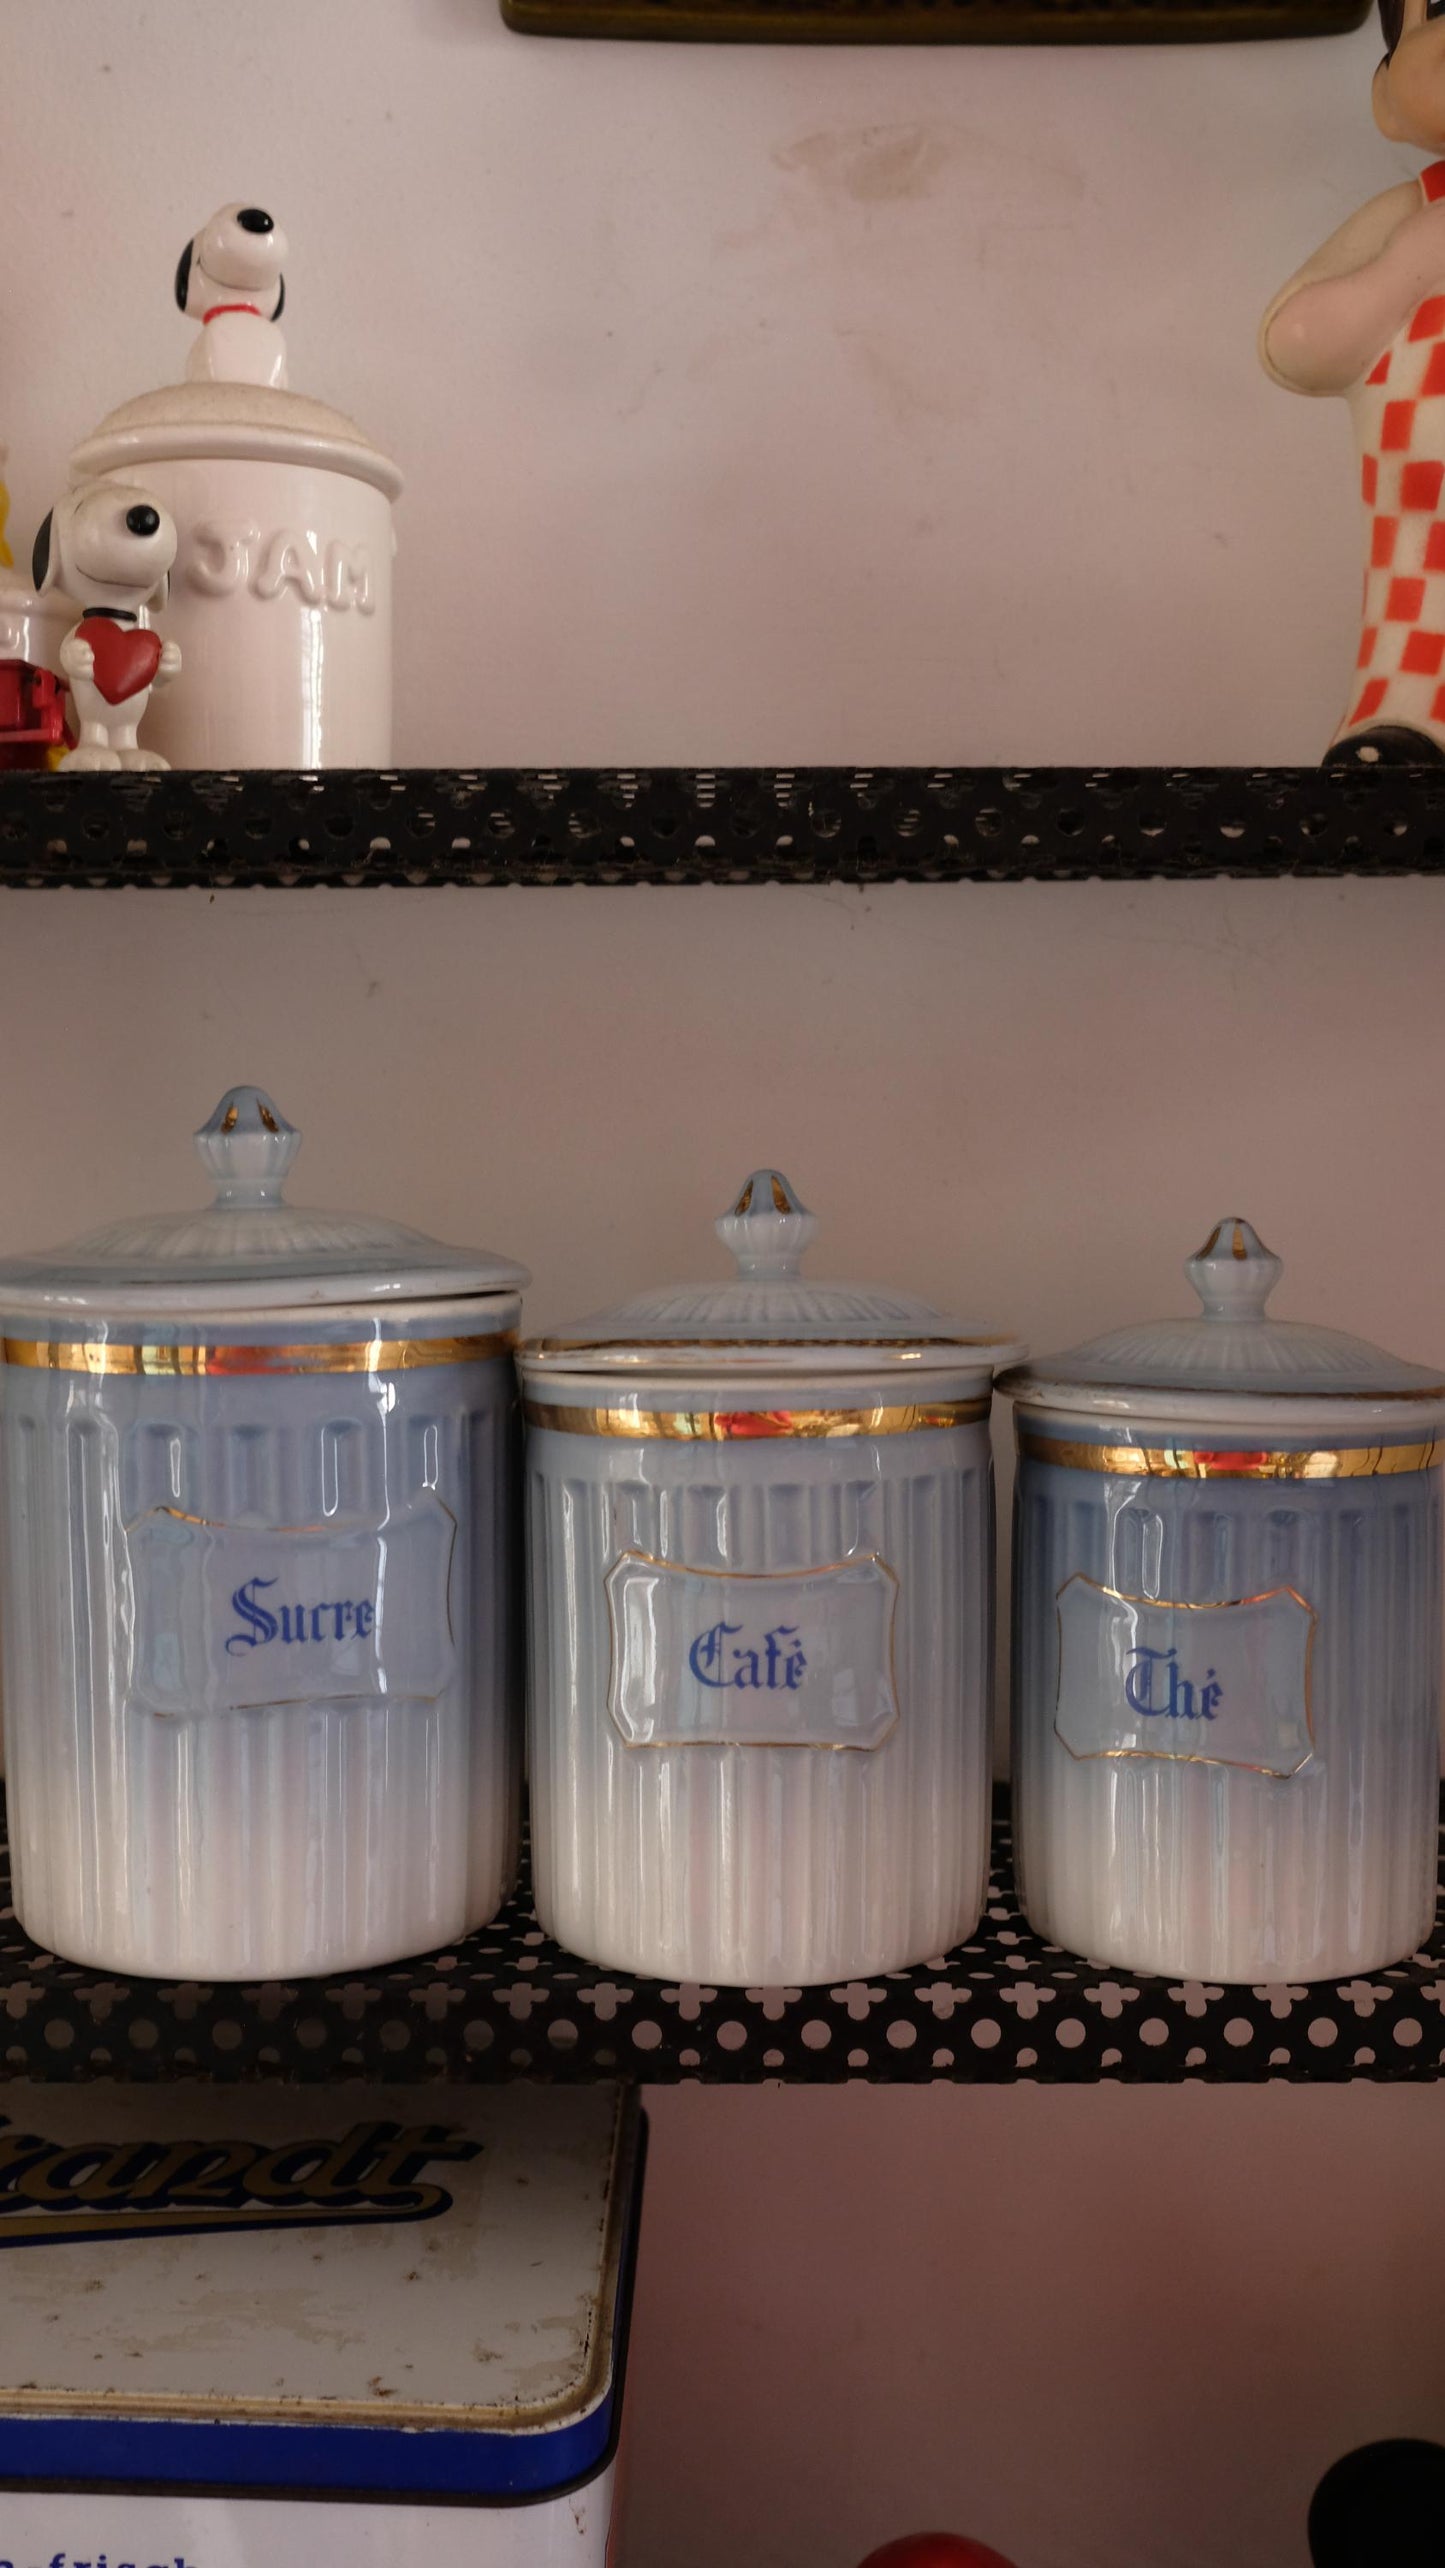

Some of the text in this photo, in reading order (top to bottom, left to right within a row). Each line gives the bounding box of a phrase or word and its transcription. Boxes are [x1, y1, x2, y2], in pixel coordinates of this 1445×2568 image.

[225, 1576, 375, 1657] Sucre
[688, 1620, 808, 1690] Café
[1125, 1645, 1223, 1721] Thé
[0, 2115, 483, 2222] randt
